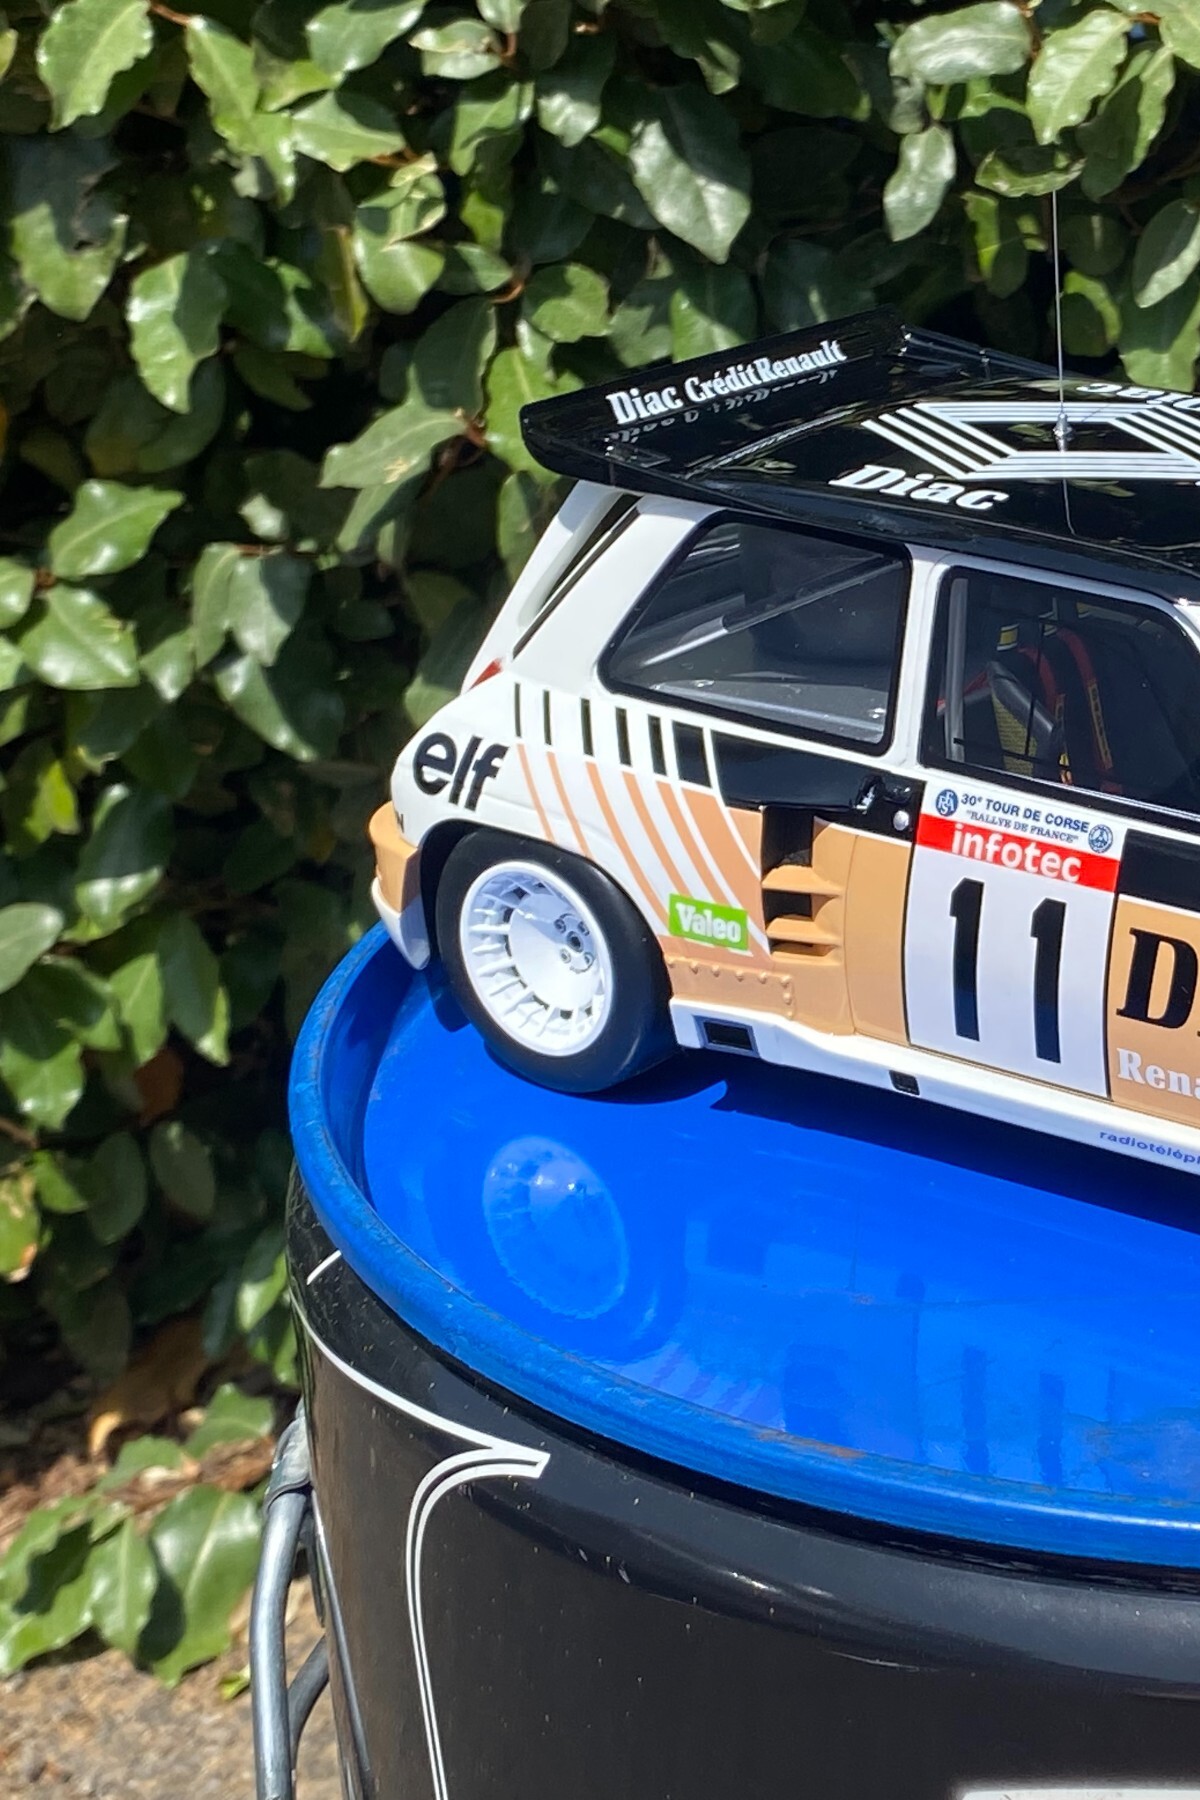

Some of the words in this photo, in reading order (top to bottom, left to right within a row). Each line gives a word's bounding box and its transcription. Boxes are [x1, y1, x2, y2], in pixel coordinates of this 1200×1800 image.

[606, 385, 683, 424] Diac
[829, 464, 1009, 510] Diac
[412, 733, 510, 812] elf
[986, 798, 1020, 817] TOUR
[1022, 808, 1041, 821] DE
[1045, 813, 1090, 833] CORSE
[1013, 820, 1028, 832] DE
[951, 823, 1082, 883] infotec
[675, 902, 741, 943] Valeo
[950, 877, 1067, 1064] 11
